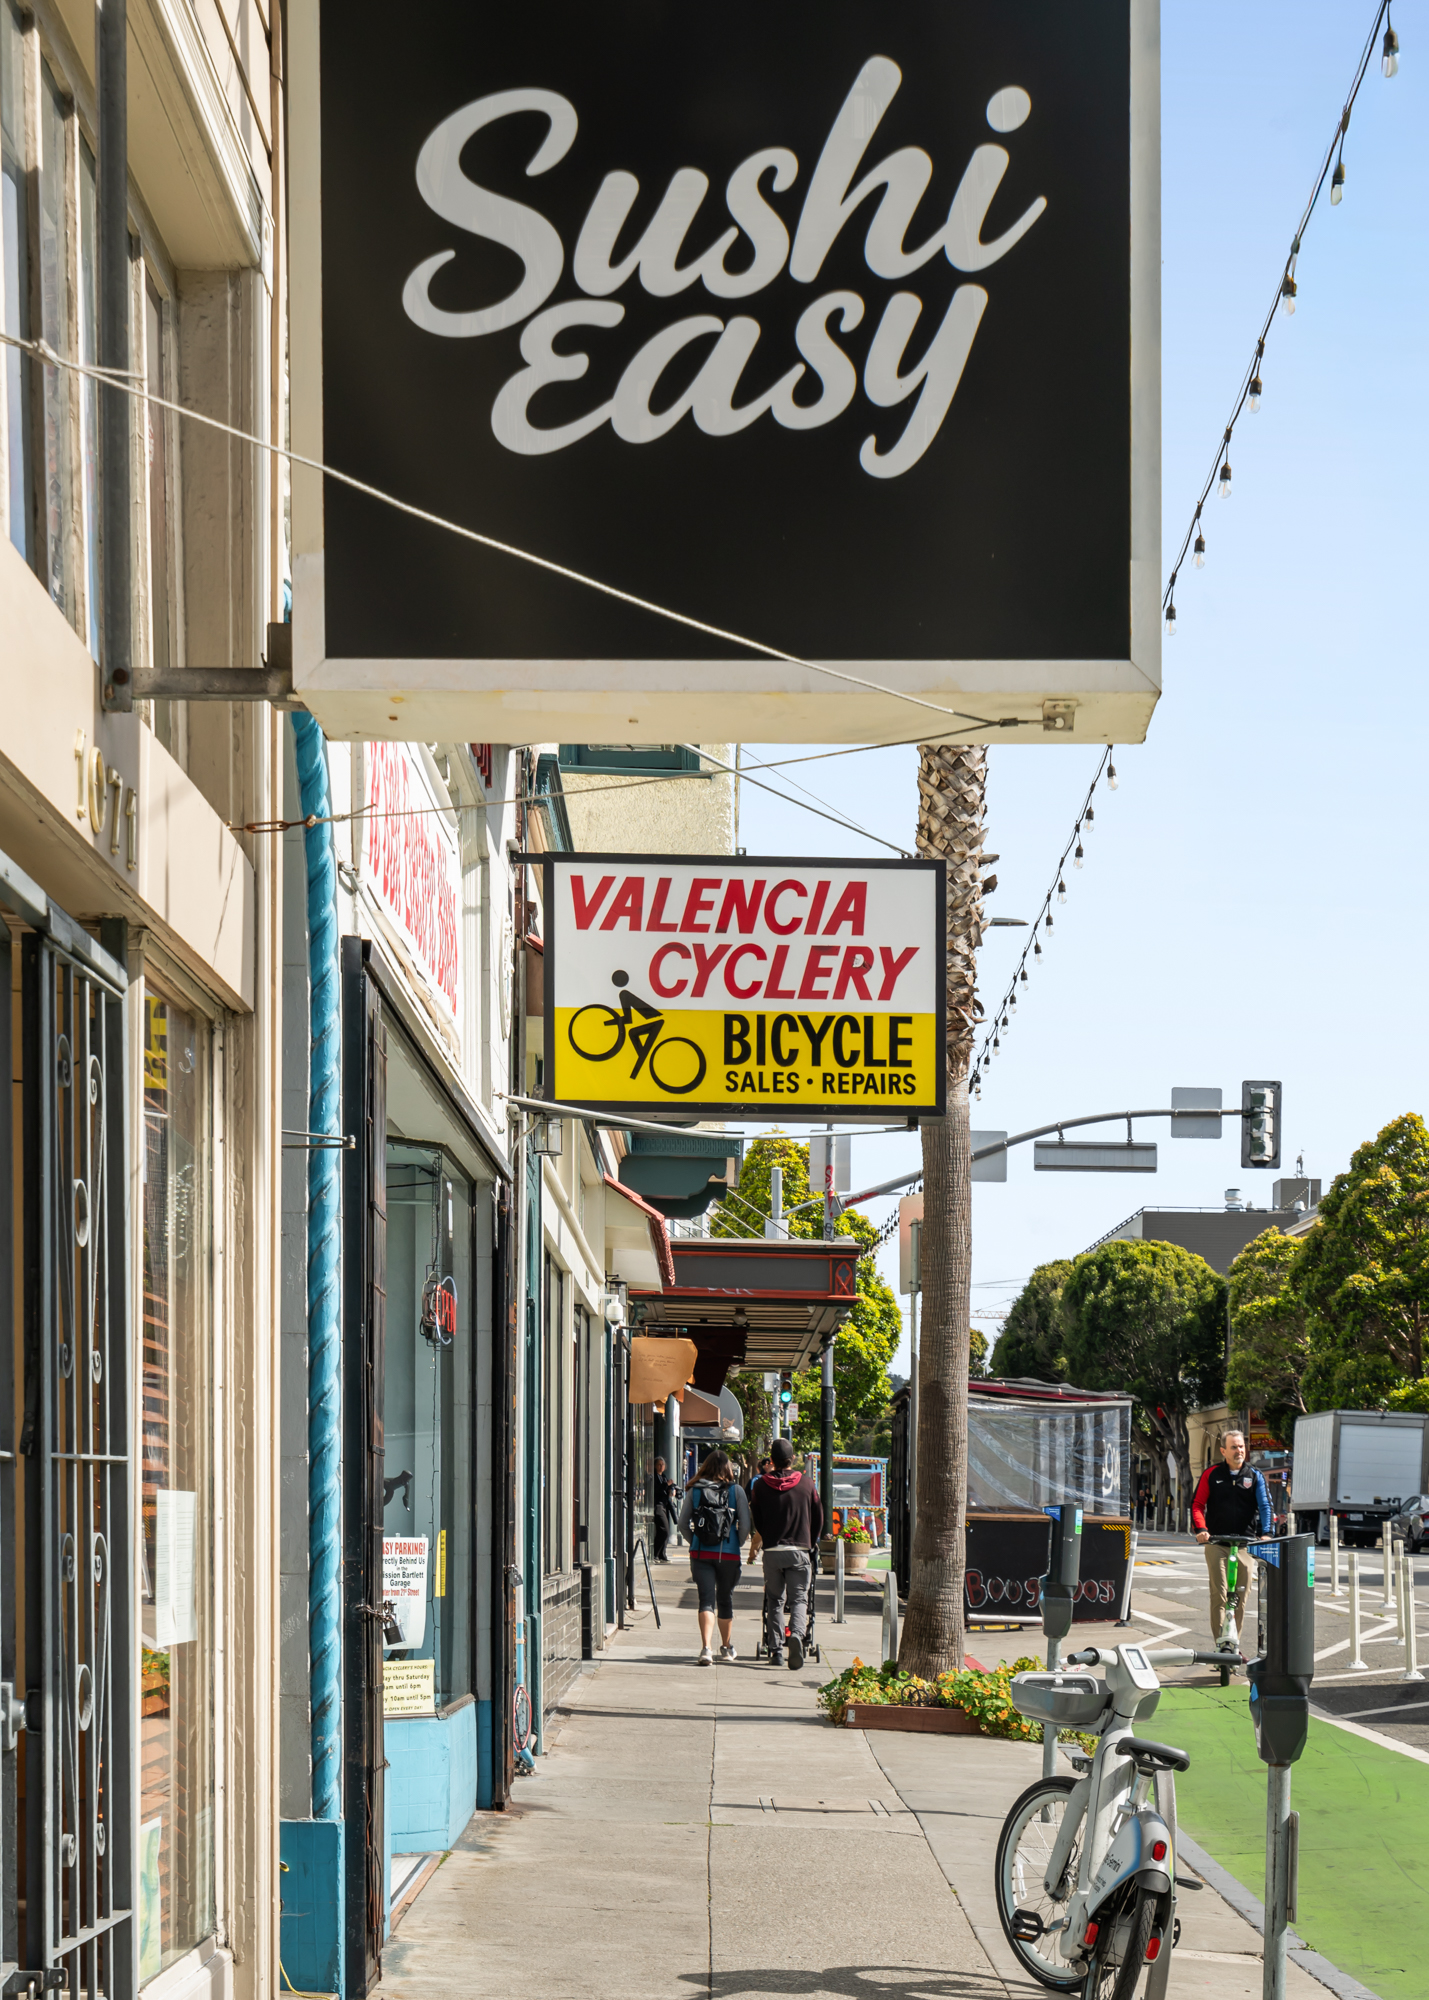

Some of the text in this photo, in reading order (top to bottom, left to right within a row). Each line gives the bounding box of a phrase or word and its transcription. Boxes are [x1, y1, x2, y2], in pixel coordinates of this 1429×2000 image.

[402, 54, 1047, 337] Sushi
[491, 283, 988, 479] Easy
[75, 728, 137, 871] 1071
[570, 875, 868, 936] VALENCIA
[648, 941, 920, 1001] CYCLERY
[723, 1013, 914, 1069] BICYCLE
[725, 1071, 917, 1096] SALES REPAIRS
[395, 1542, 426, 1555] PARKING!
[399, 1557, 417, 1565] Behind
[383, 1571, 424, 1579] ission Bartlett
[390, 1579, 411, 1588] Garage
[406, 1673, 430, 1681] Saturday
